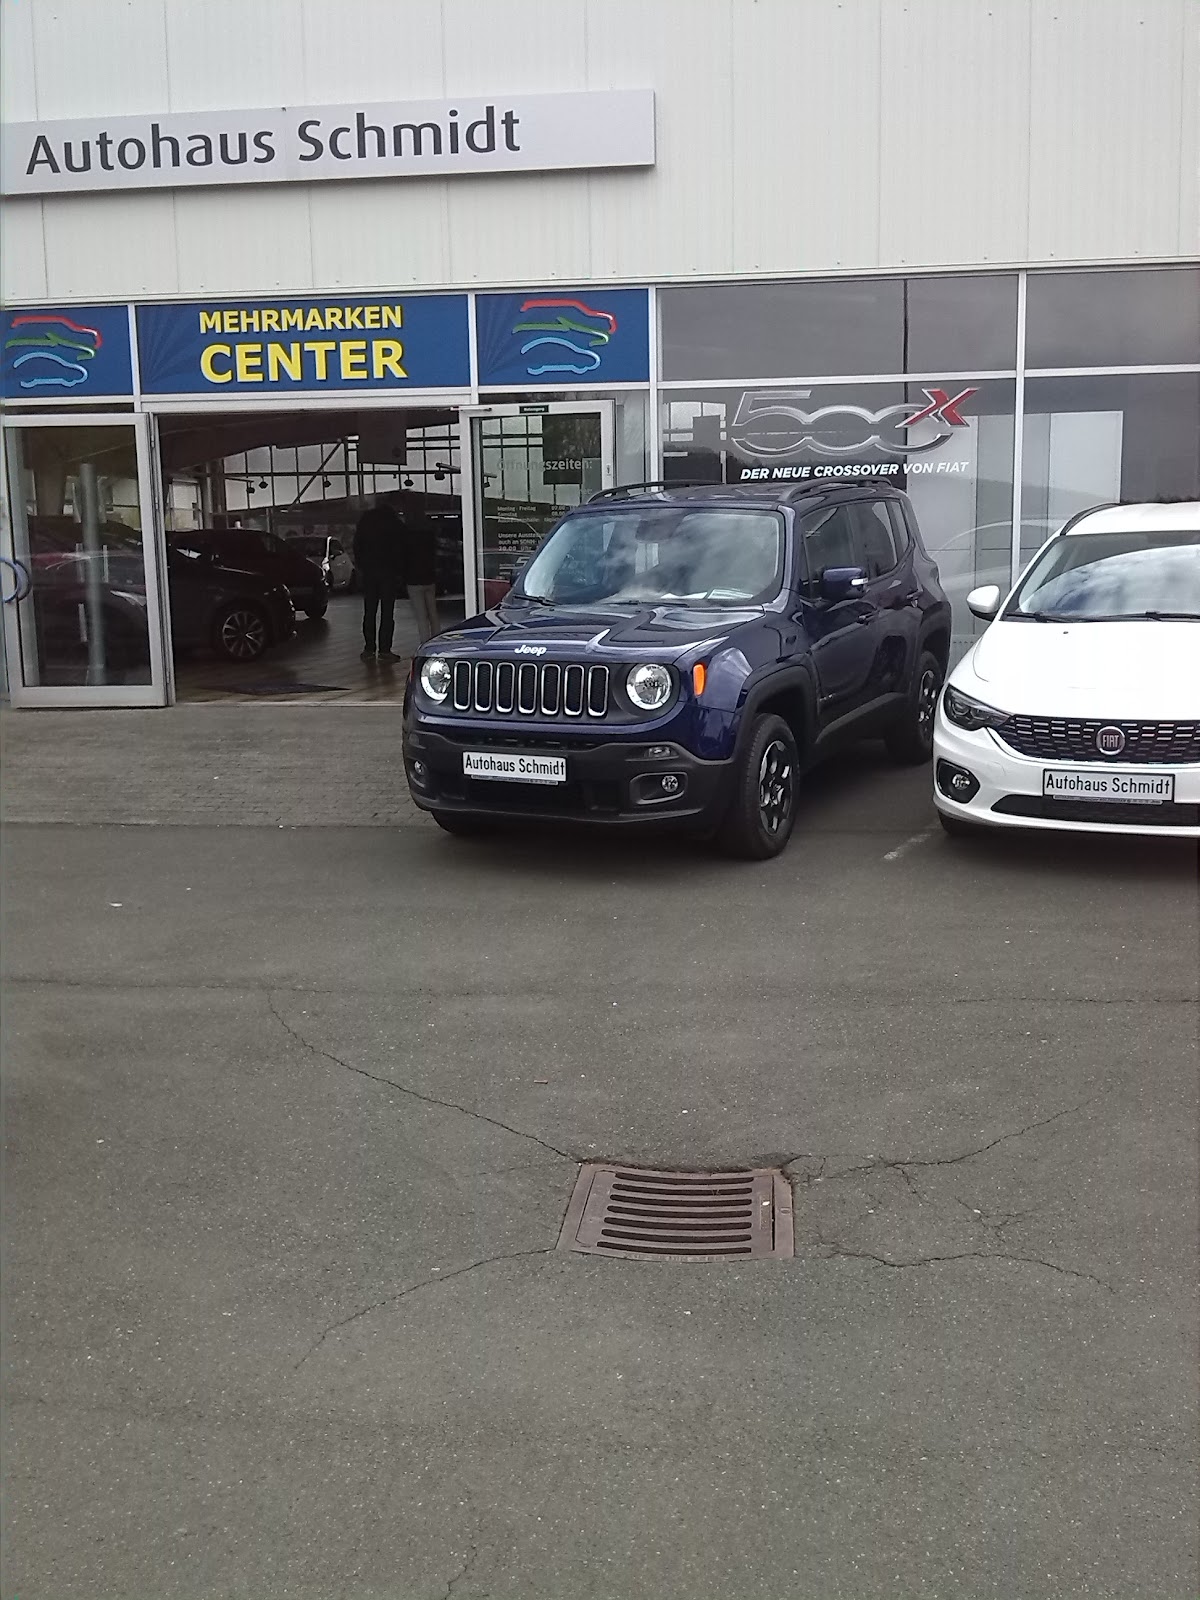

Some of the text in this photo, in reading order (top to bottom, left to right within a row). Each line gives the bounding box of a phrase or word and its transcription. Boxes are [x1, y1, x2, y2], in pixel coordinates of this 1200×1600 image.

[26, 105, 521, 175] Autohaus Schmidt
[199, 305, 402, 334] MEHRMARKEN
[200, 339, 408, 384] CENTER
[740, 461, 969, 480] DER NEUE CROSSOVER VON FIAT
[514, 644, 547, 657] Jeep
[1102, 734, 1120, 748] FIAT
[465, 754, 565, 775] Autohaus Schmidt
[1046, 773, 1170, 794] Autohaus Schmidt
